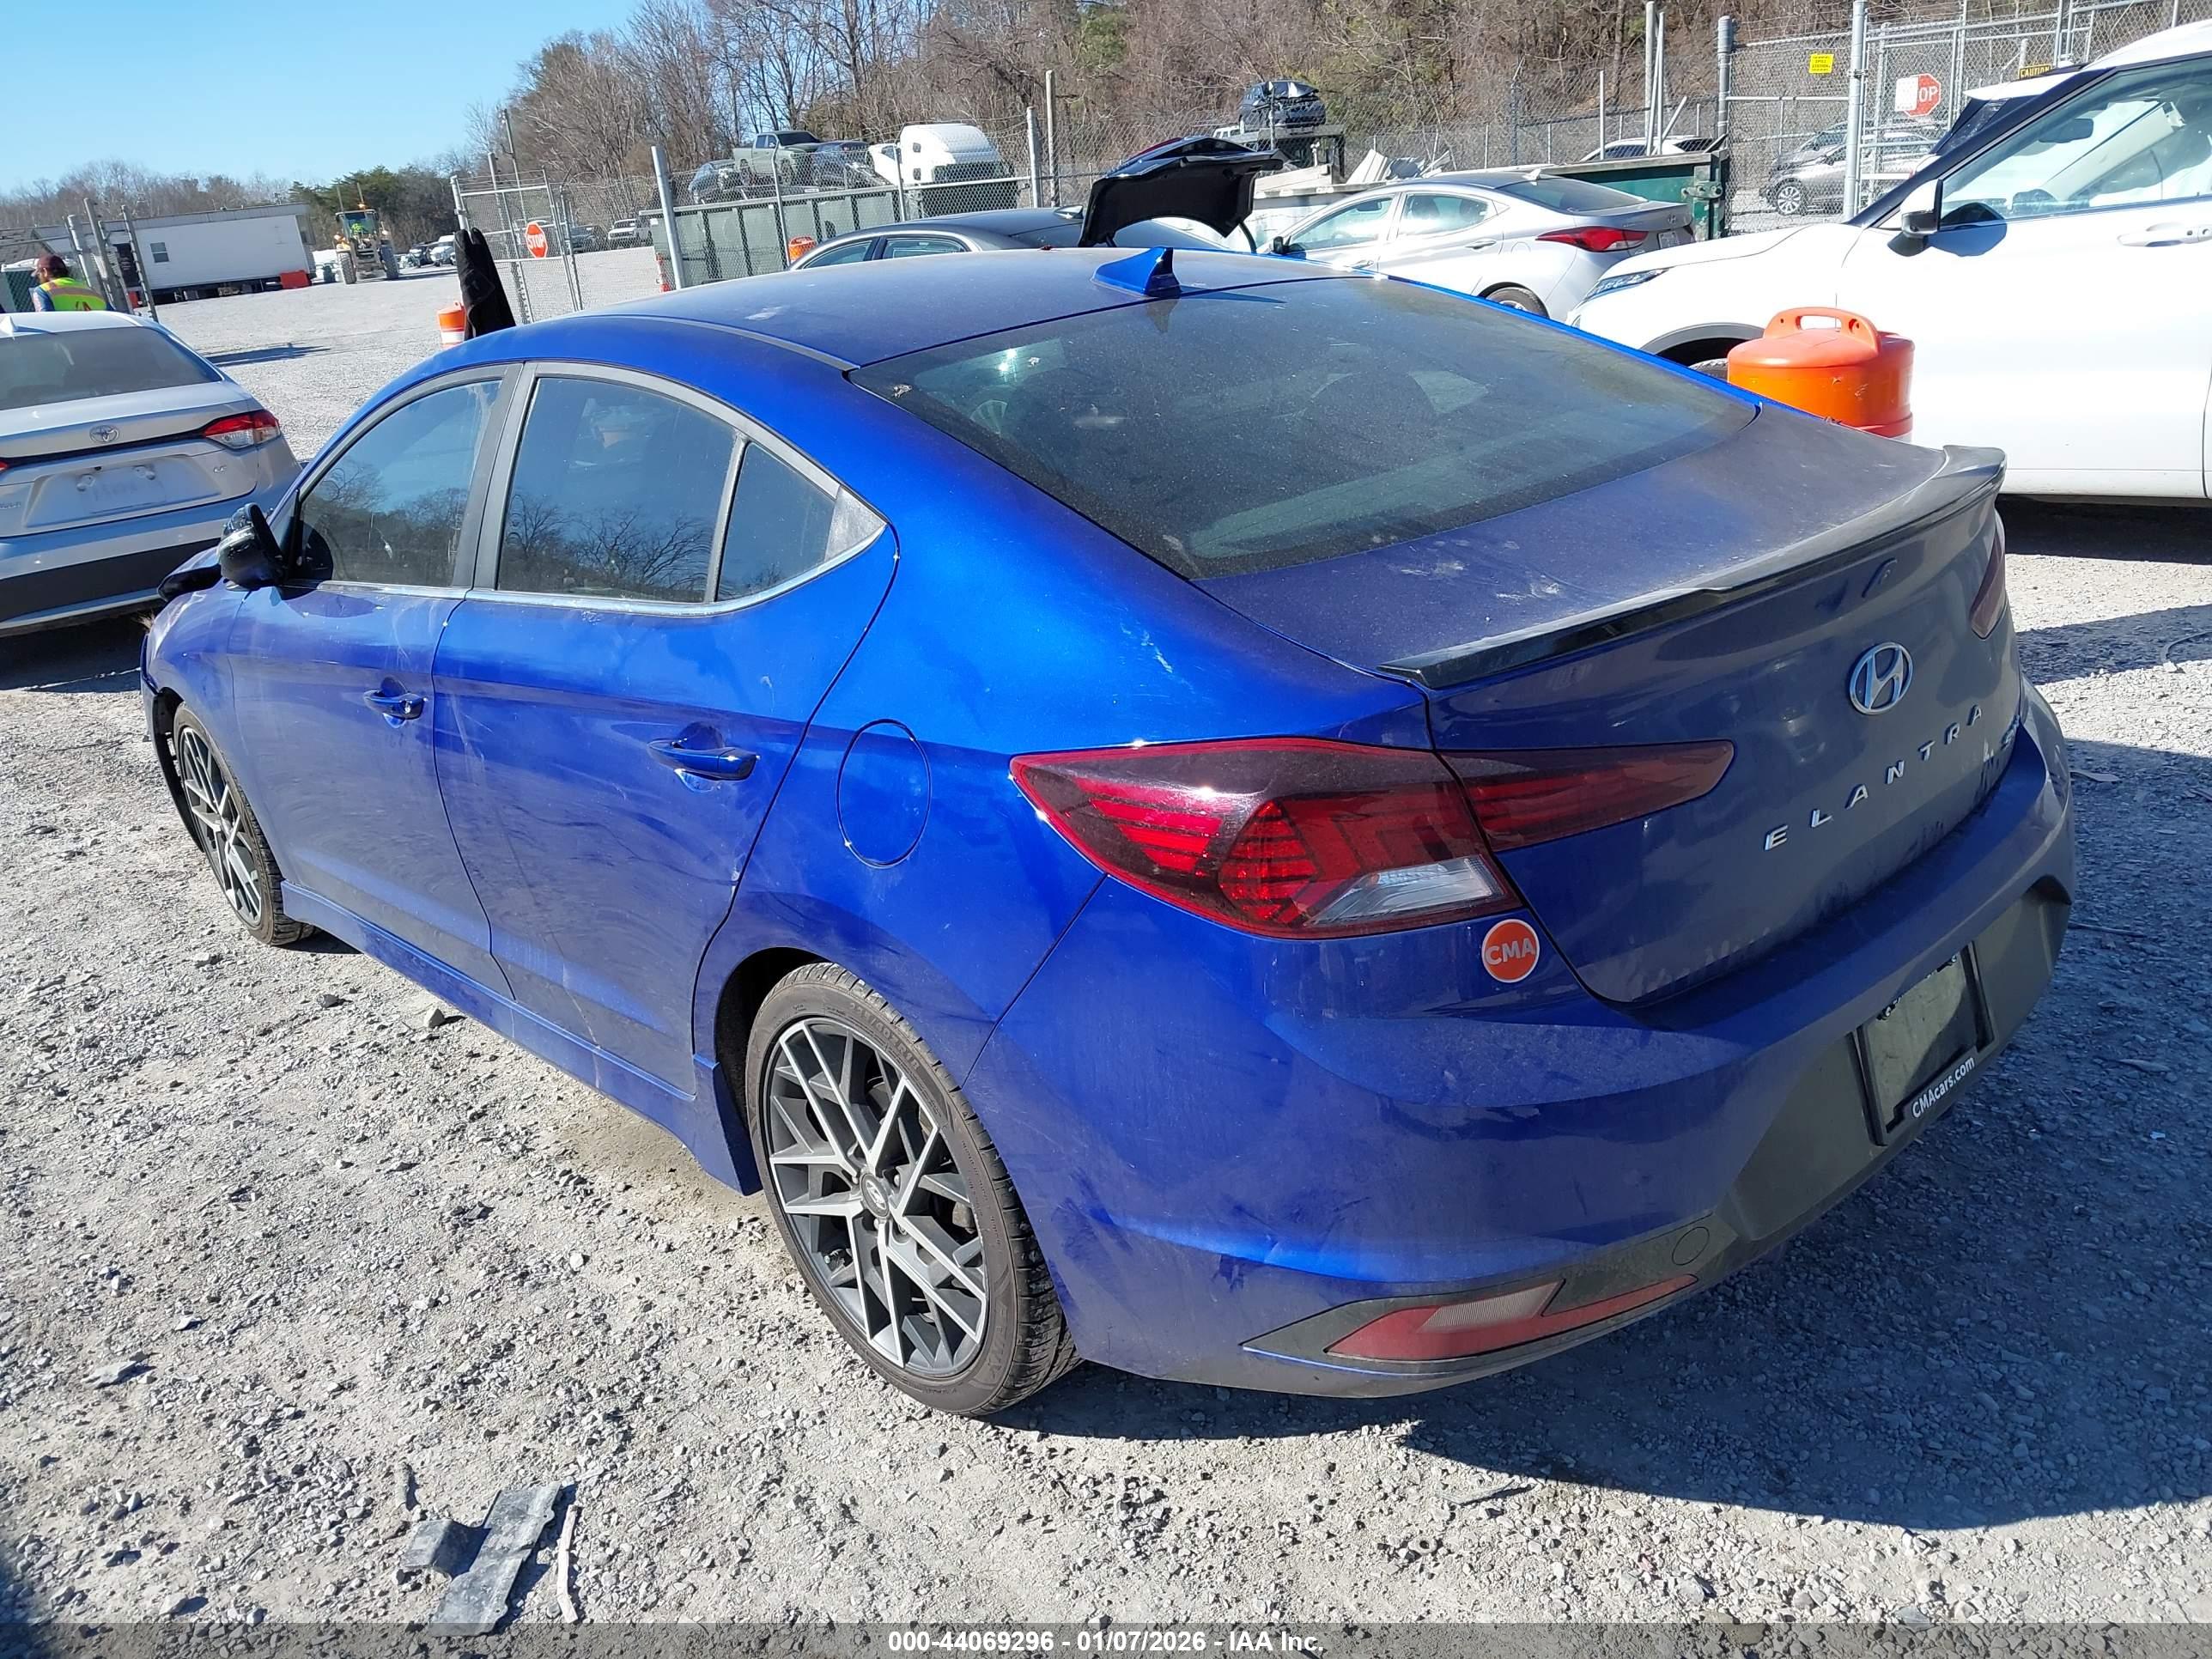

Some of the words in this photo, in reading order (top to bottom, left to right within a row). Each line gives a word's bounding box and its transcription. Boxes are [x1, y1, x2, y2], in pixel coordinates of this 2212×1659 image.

[2021, 66, 2050, 77] CAUTION
[1918, 86, 1938, 102] OP
[527, 234, 545, 249] STOP
[1764, 704, 1982, 851] ELANTRA
[1486, 938, 1536, 965] CMA
[1911, 1055, 1975, 1118] CMAcars.com
